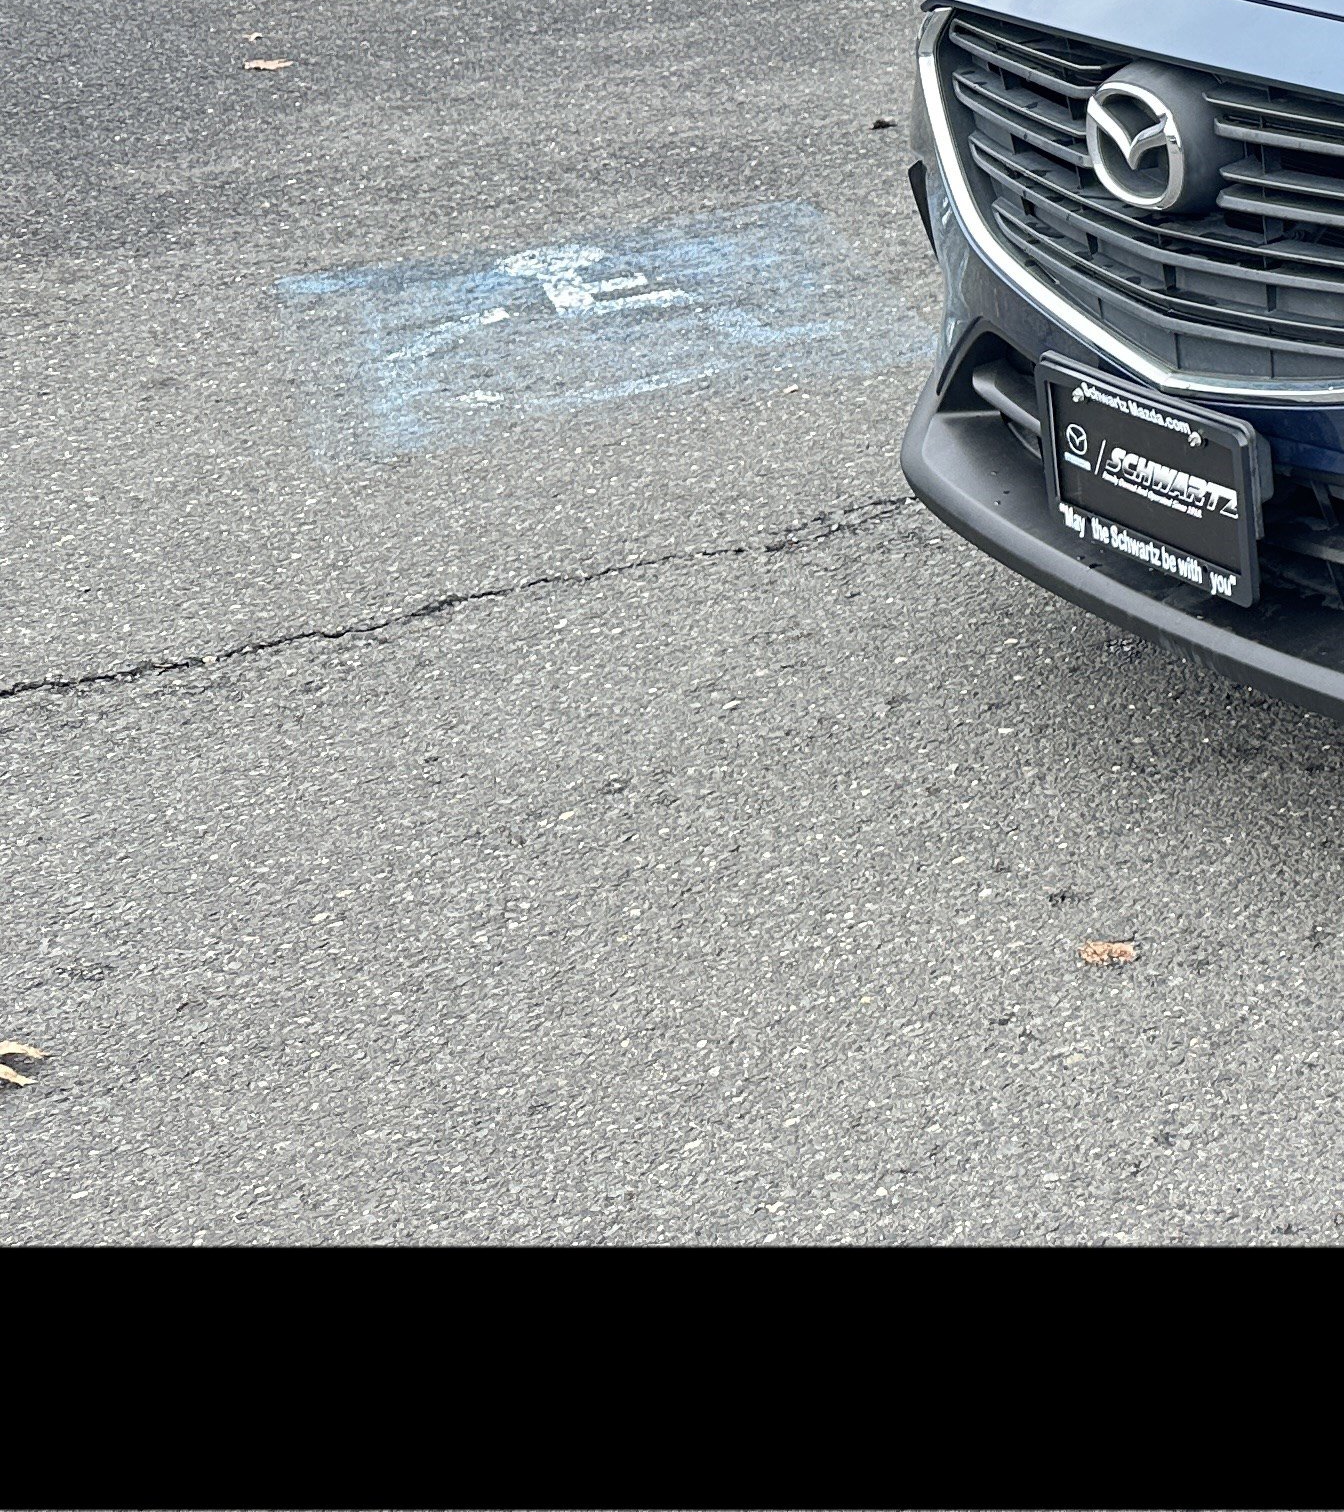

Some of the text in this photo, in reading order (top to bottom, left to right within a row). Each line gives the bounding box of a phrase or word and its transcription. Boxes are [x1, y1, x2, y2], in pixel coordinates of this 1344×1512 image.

[1105, 447, 1239, 520] SCHWARTZ
[1091, 517, 1109, 544] the
[1110, 525, 1161, 566] Schwartz
[1161, 546, 1177, 573] be
[1177, 557, 1203, 584] with
